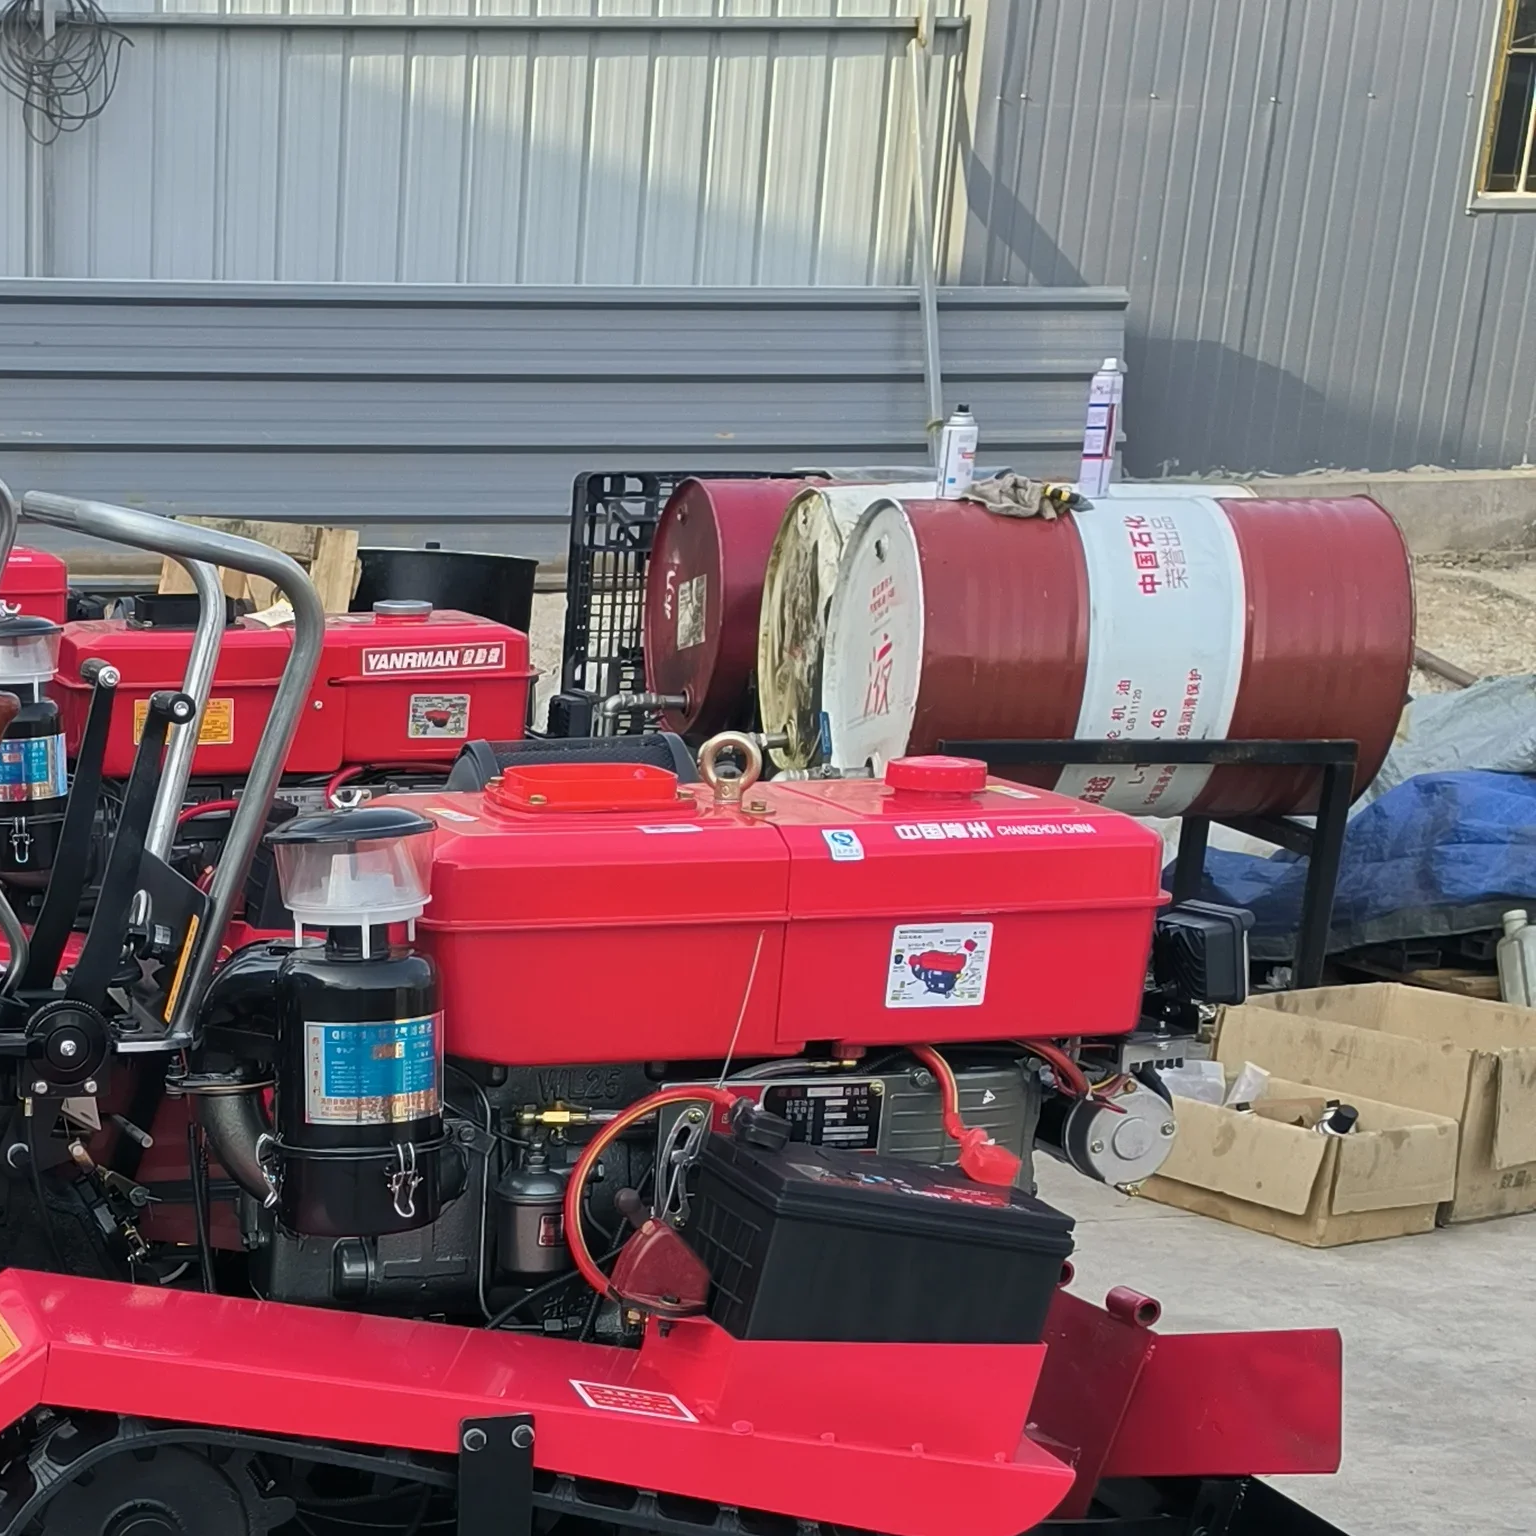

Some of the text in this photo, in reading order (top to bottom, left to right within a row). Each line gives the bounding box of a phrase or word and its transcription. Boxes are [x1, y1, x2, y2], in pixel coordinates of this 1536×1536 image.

[1123, 515, 1162, 594] 中国石化
[1150, 516, 1189, 589] 荣誉出品
[1151, 708, 1168, 728] 46
[997, 823, 1097, 836] CHANGZHOU CHINA
